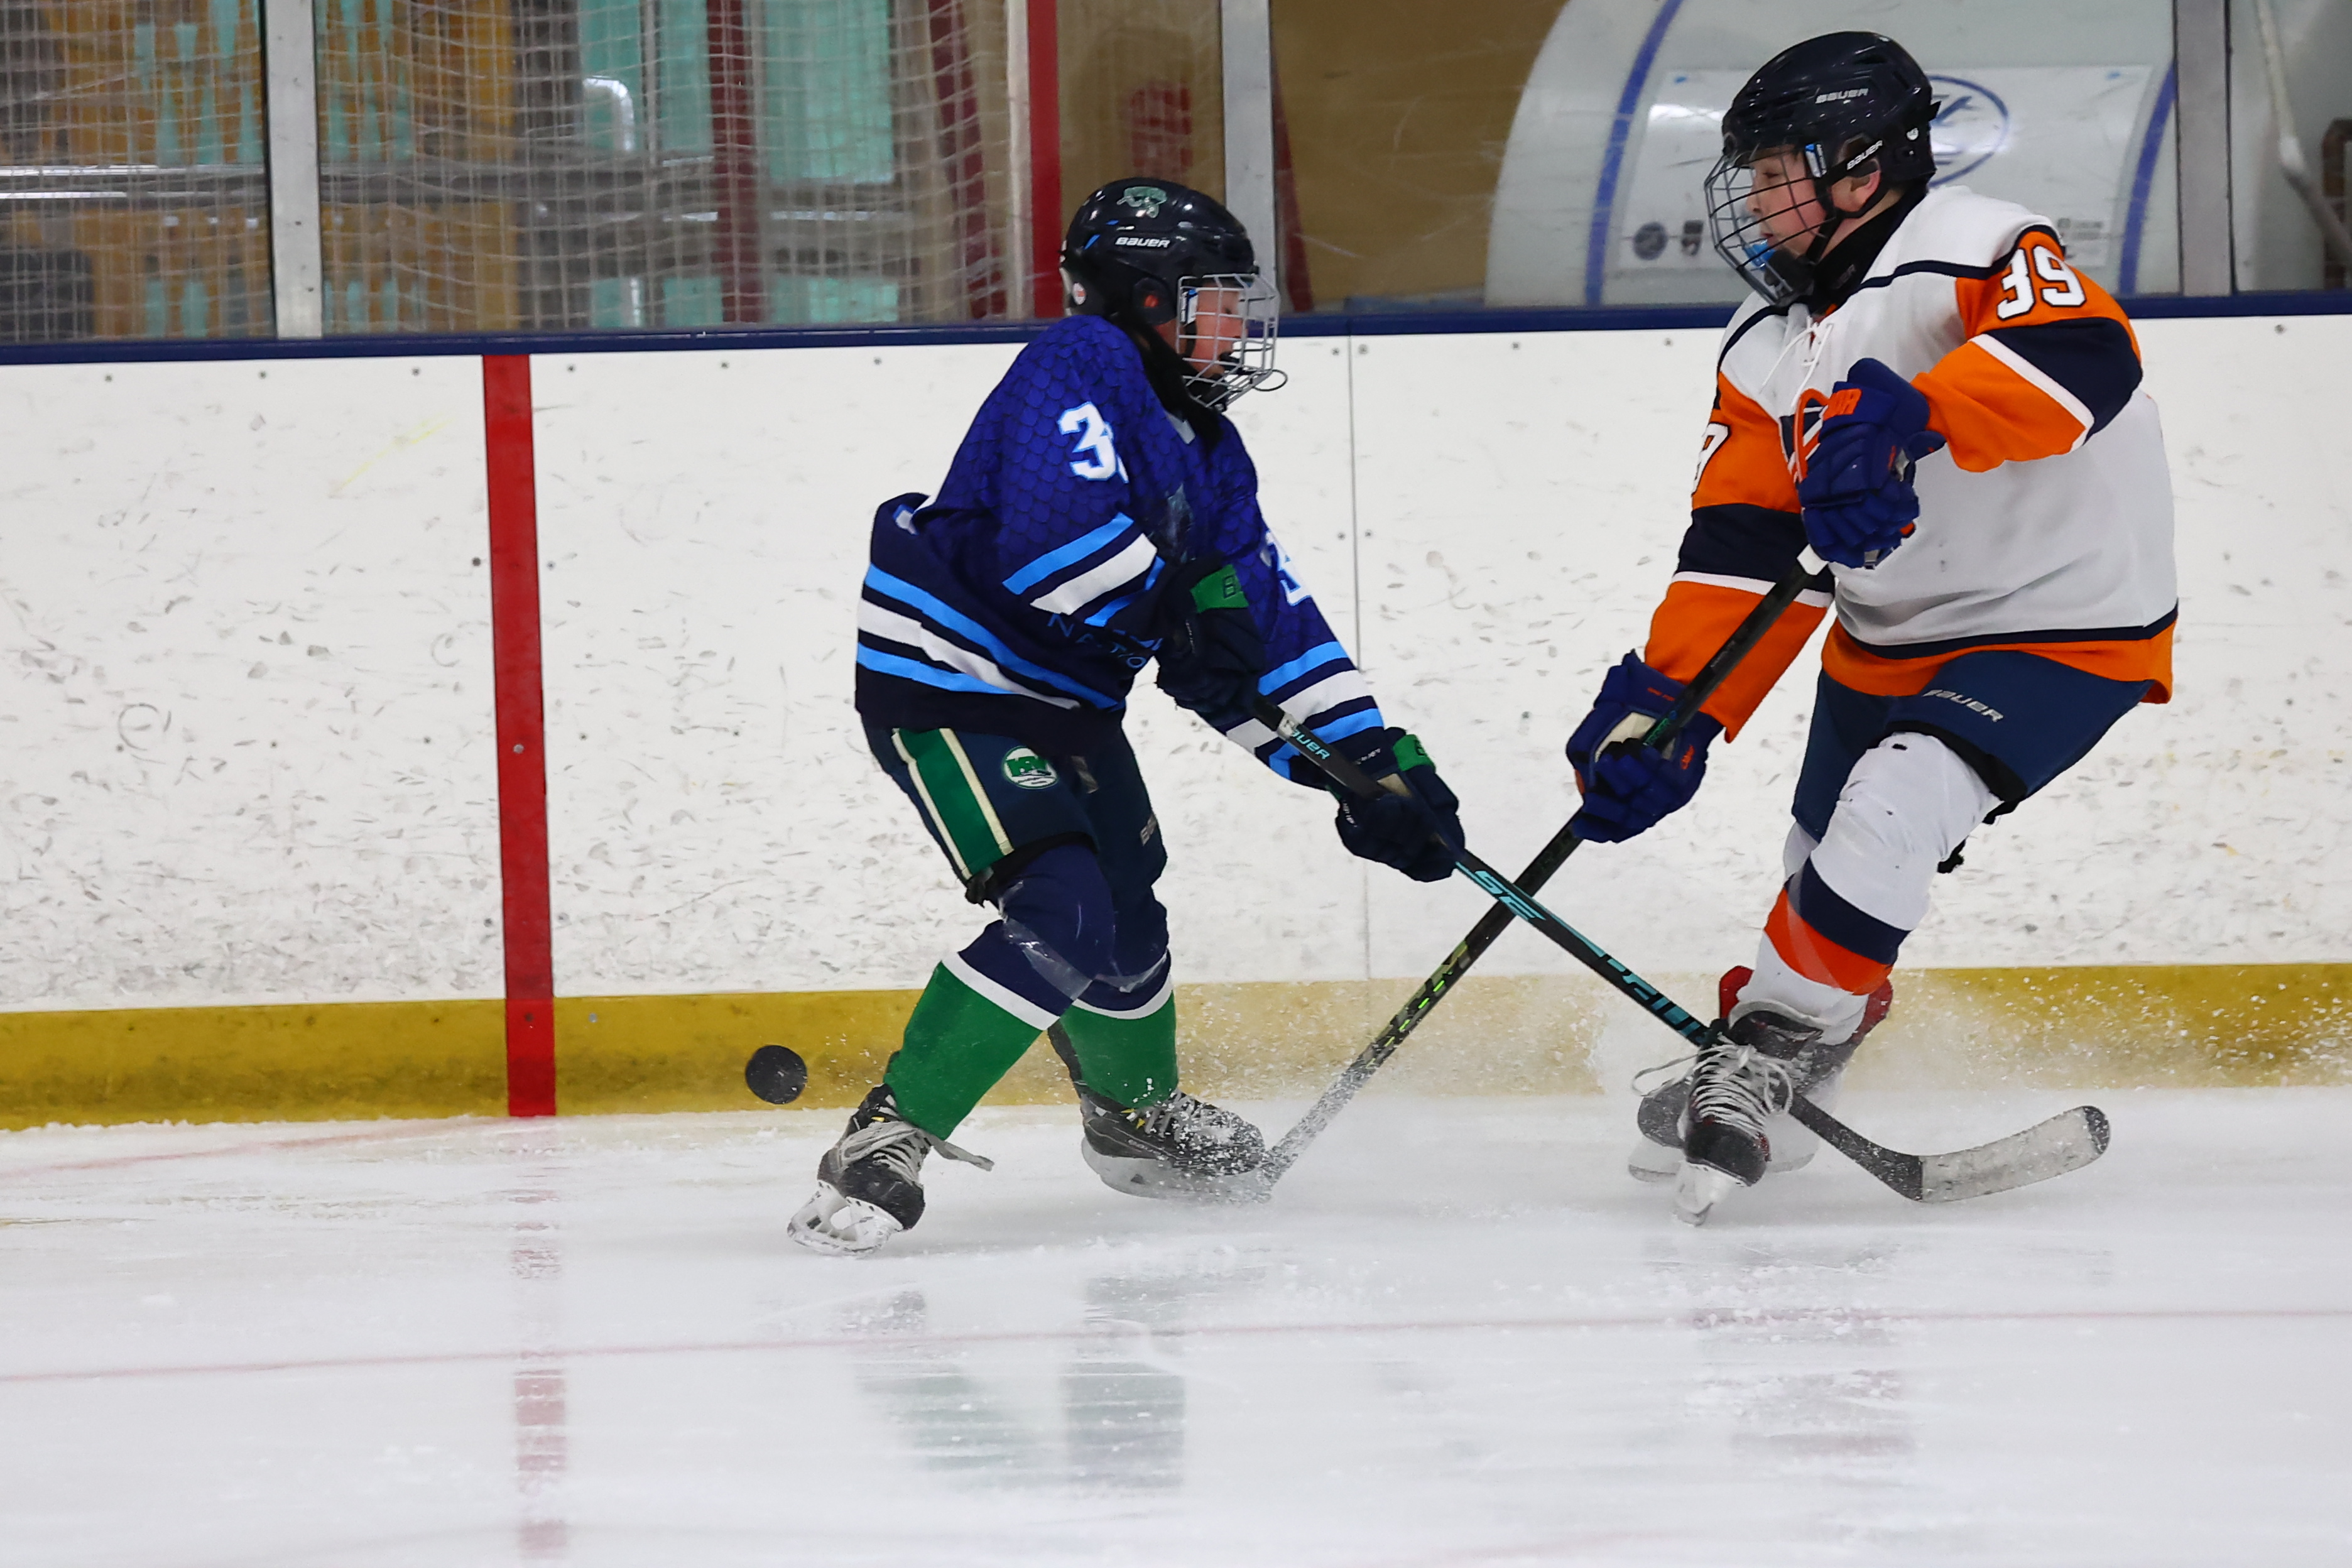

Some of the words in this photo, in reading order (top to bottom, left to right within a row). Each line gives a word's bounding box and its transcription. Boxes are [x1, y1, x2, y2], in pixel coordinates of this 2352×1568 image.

[1115, 237, 1170, 248] BAUER
[1996, 244, 2087, 321] 39
[1057, 401, 1130, 484] 3
